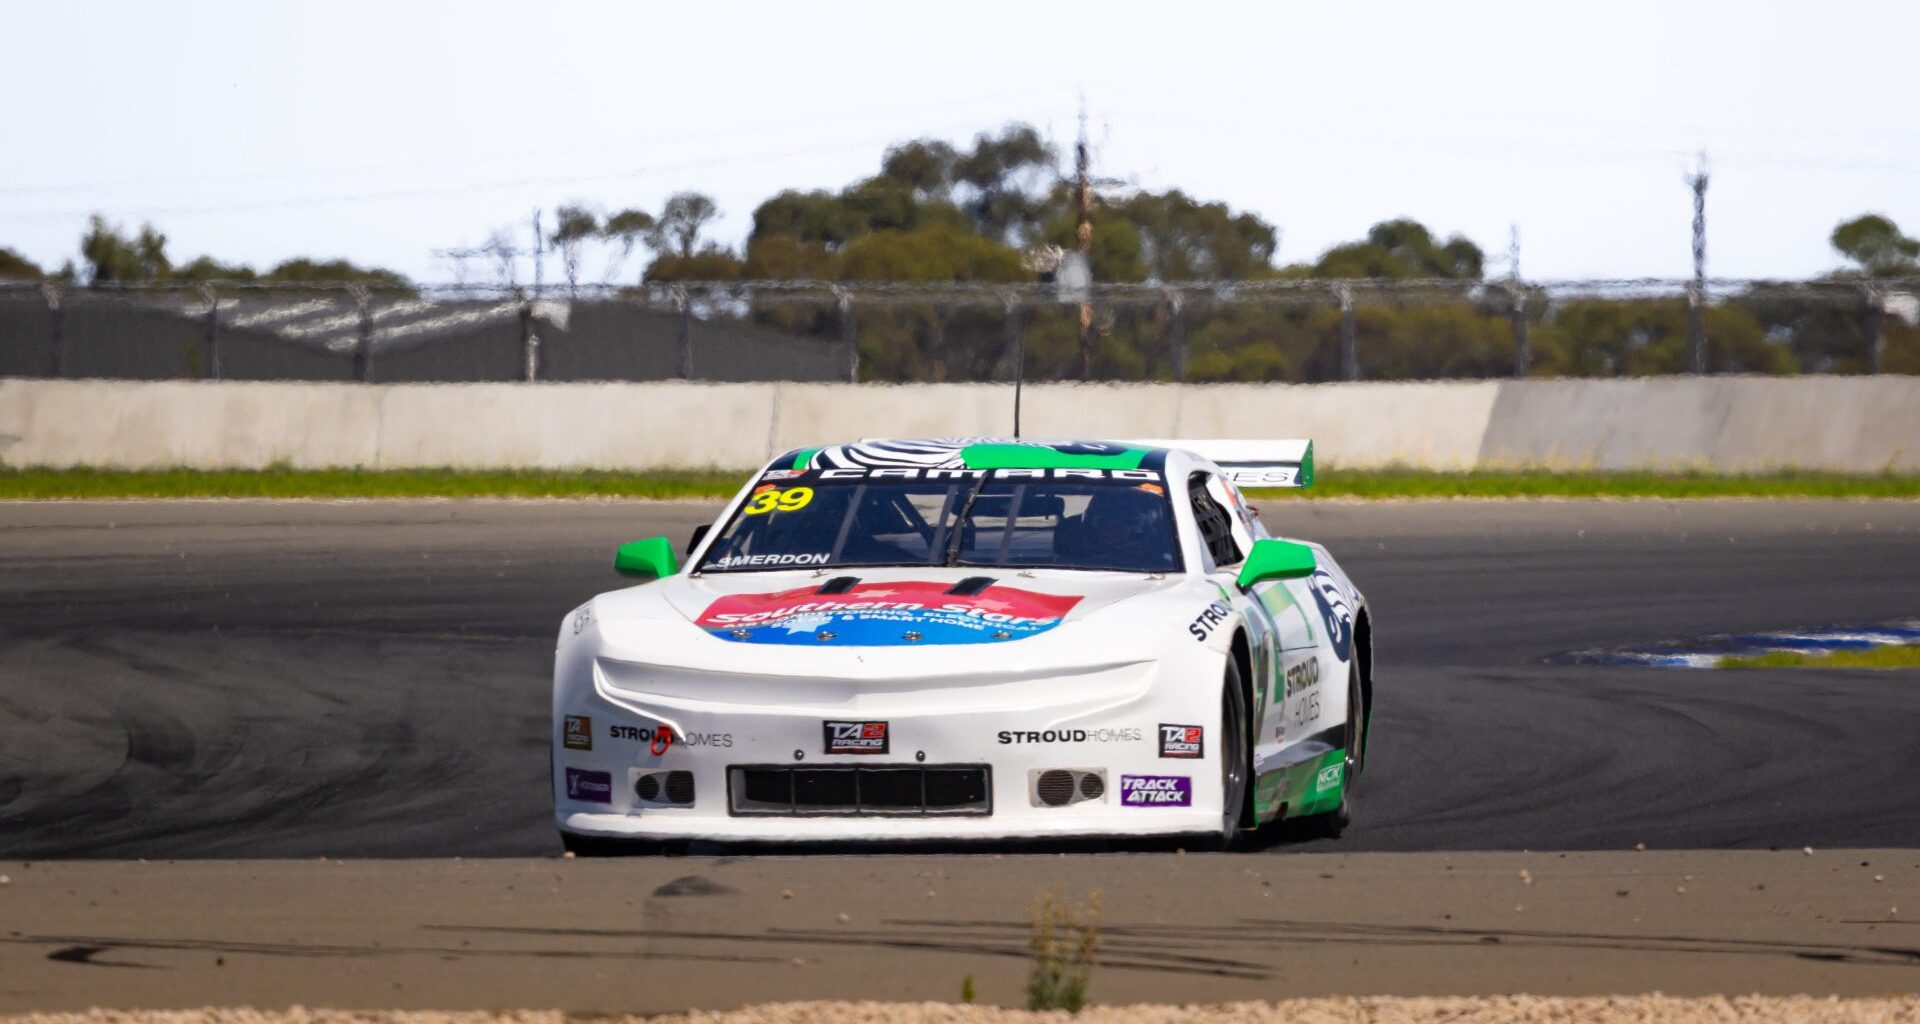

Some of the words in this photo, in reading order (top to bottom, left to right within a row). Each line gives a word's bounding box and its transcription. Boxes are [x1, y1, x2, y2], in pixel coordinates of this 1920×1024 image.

[819, 468, 1160, 480] CAMARO
[743, 486, 814, 515] 39
[717, 553, 830, 568] SMERDON
[706, 601, 924, 623] Southern
[933, 603, 1056, 626] Stars
[859, 614, 926, 622] SMART
[929, 616, 985, 630] HOME
[1286, 656, 1319, 698] STROUD
[827, 722, 886, 739] TA2
[1161, 726, 1200, 743] TA2
[831, 738, 883, 746] RACING
[1122, 778, 1178, 790] TRACK
[1126, 790, 1184, 802] ATTACK
